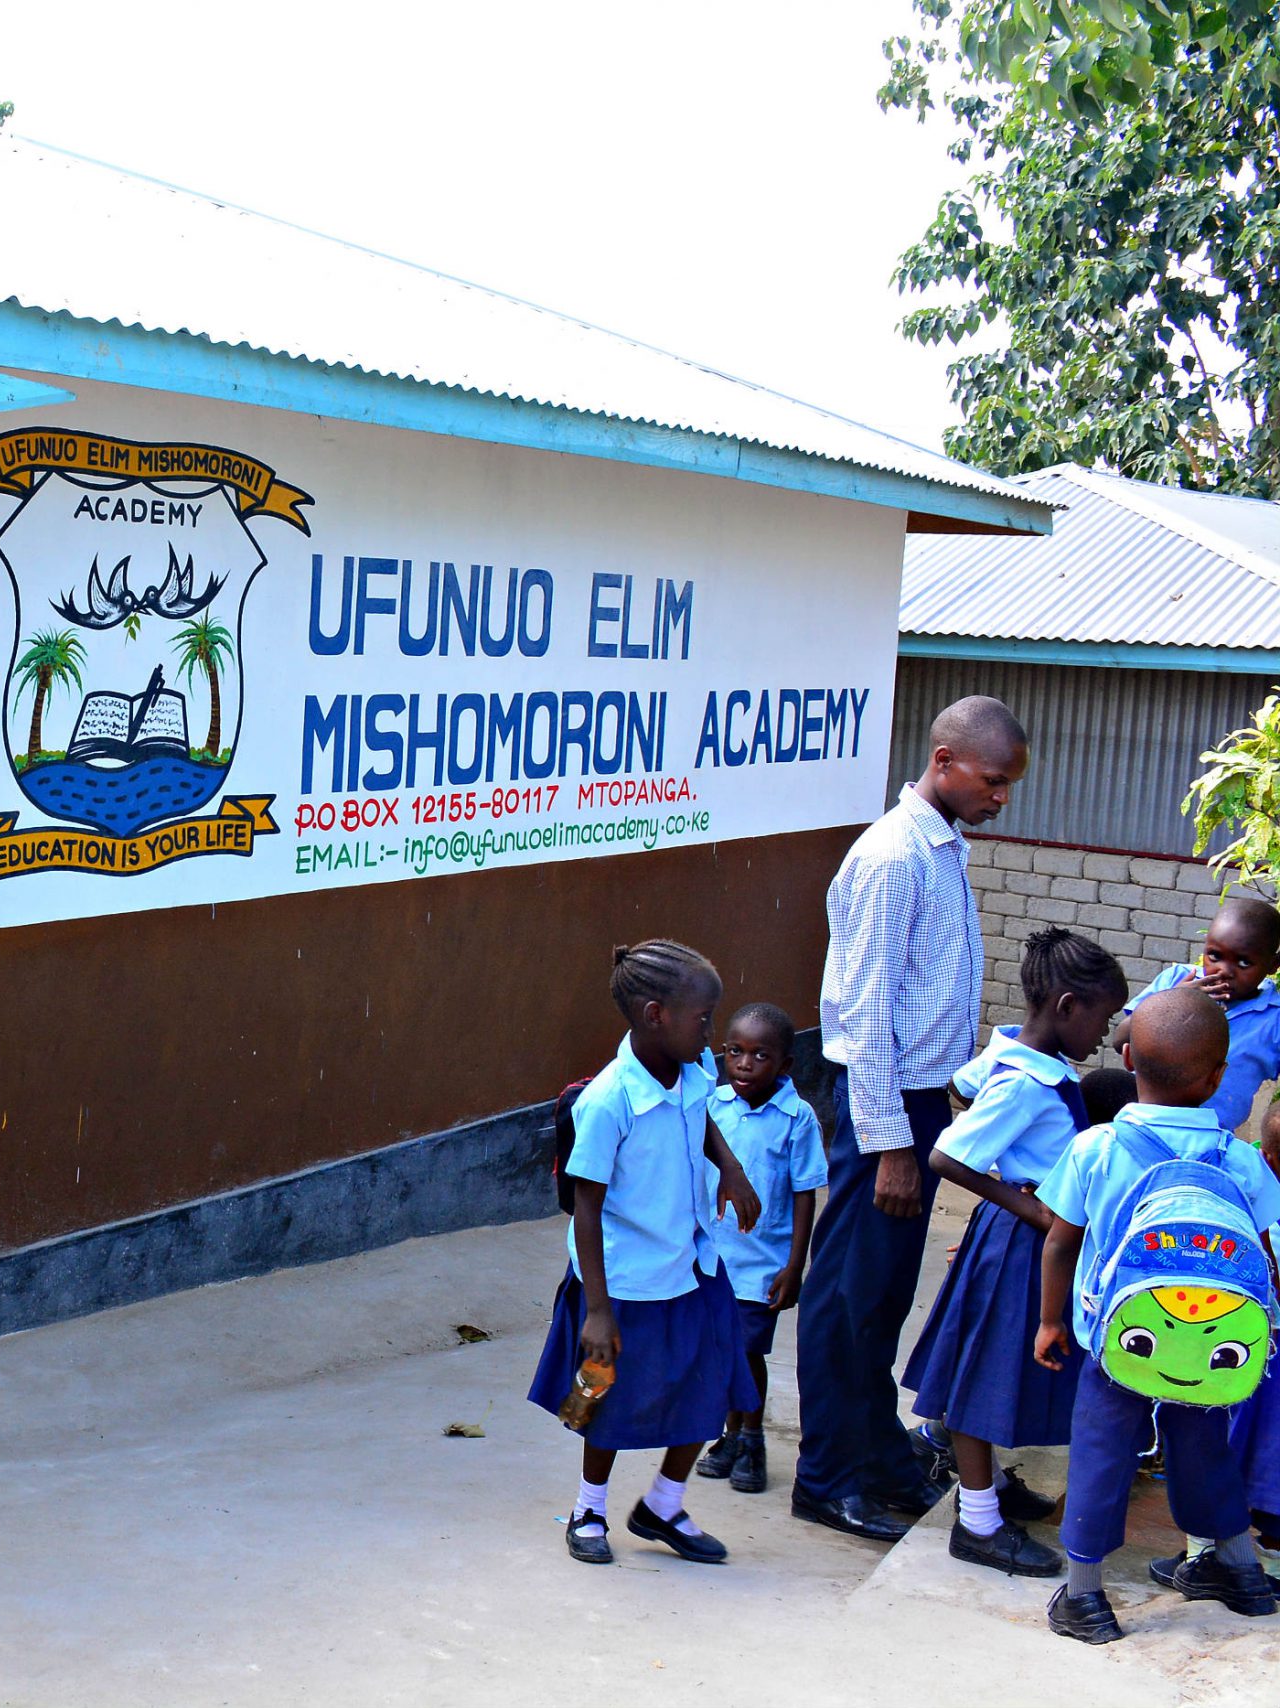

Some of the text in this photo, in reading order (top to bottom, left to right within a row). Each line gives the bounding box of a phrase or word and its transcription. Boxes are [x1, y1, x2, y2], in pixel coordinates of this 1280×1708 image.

[1, 437, 262, 492] UFUNUO ELIM MISHOMORONI
[73, 494, 203, 528] ACADEMY
[308, 553, 694, 661] UFUNUO ELIM
[301, 688, 870, 795] MISHOMORONI ACADEMY
[340, 797, 399, 832] BOX
[412, 784, 560, 824] 12155-80117
[578, 776, 697, 810] MTOPANGA.
[121, 843, 140, 868] IS
[145, 825, 200, 861] YOUR
[206, 823, 247, 848] LIFE
